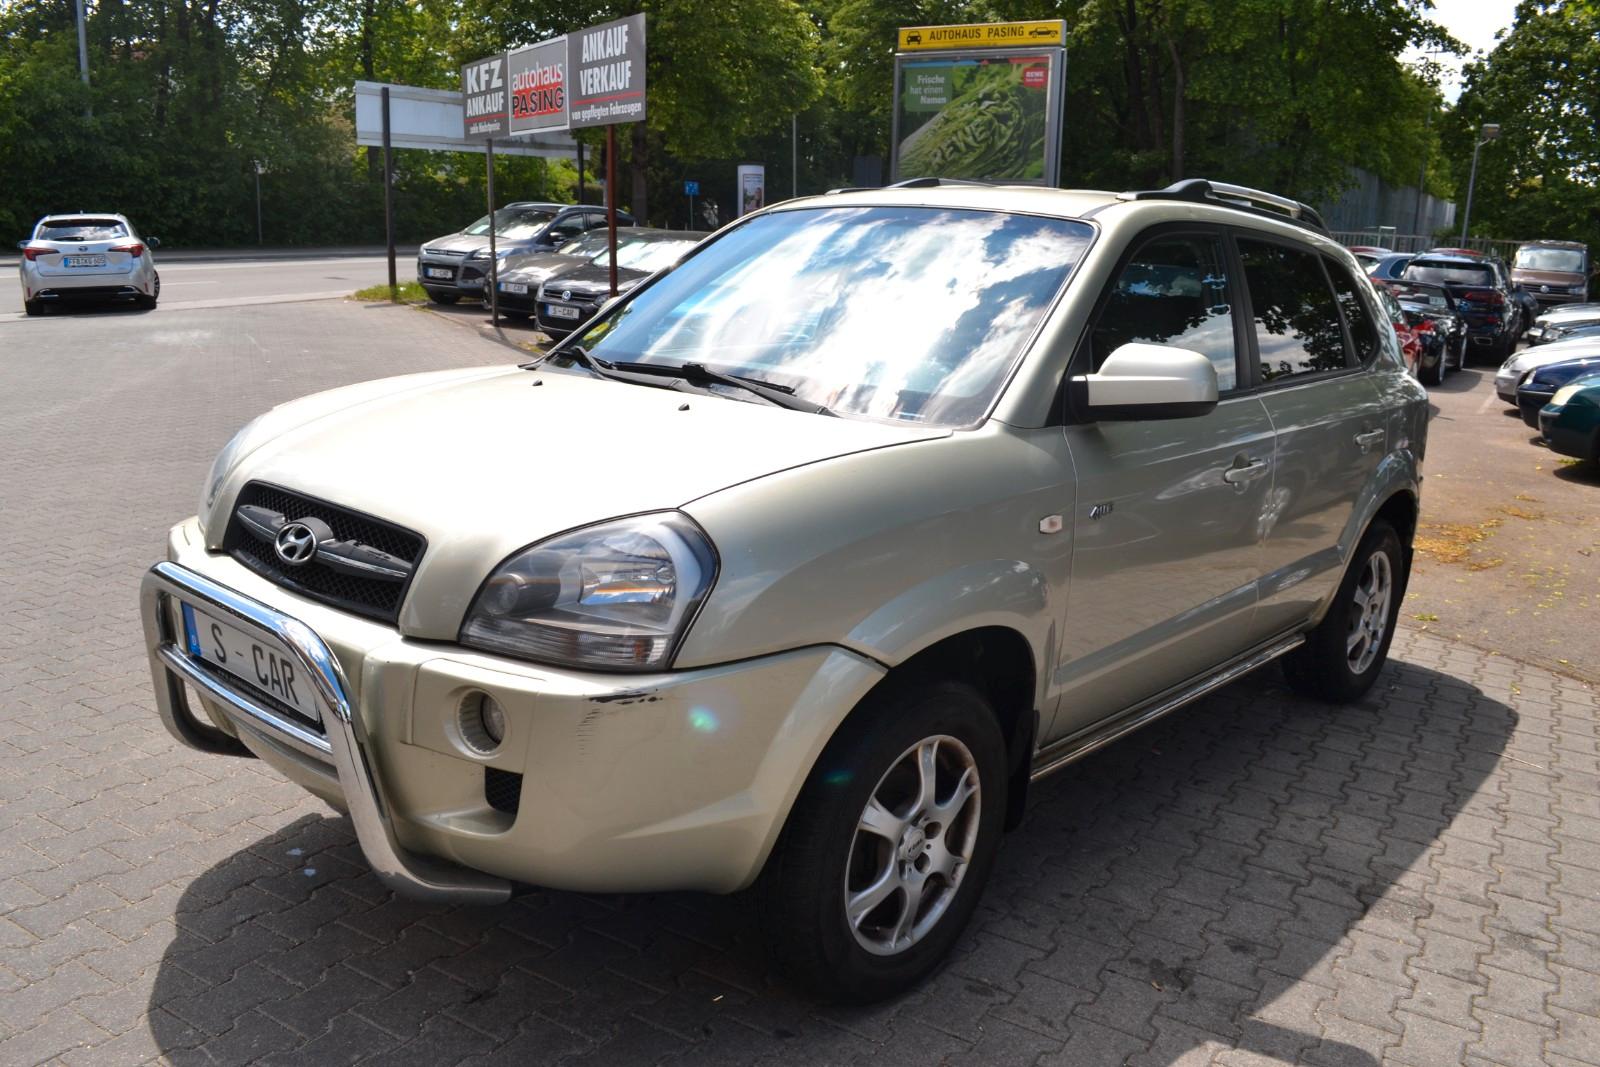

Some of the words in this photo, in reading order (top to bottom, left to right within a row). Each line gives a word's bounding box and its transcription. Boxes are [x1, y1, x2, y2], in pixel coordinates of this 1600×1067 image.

[582, 24, 629, 64] ANKAUF
[929, 28, 981, 41] AUTOHAUS
[987, 26, 1024, 38] PASING
[466, 59, 503, 95] KFZ
[512, 61, 563, 90] autohaus
[579, 60, 632, 96] VERKAUF
[917, 74, 945, 85] Frische
[466, 91, 505, 117] ANKAUF
[512, 86, 564, 115] PASING
[571, 111, 581, 120] von
[609, 100, 642, 116] Fahrzeugen
[920, 95, 947, 105] Namen
